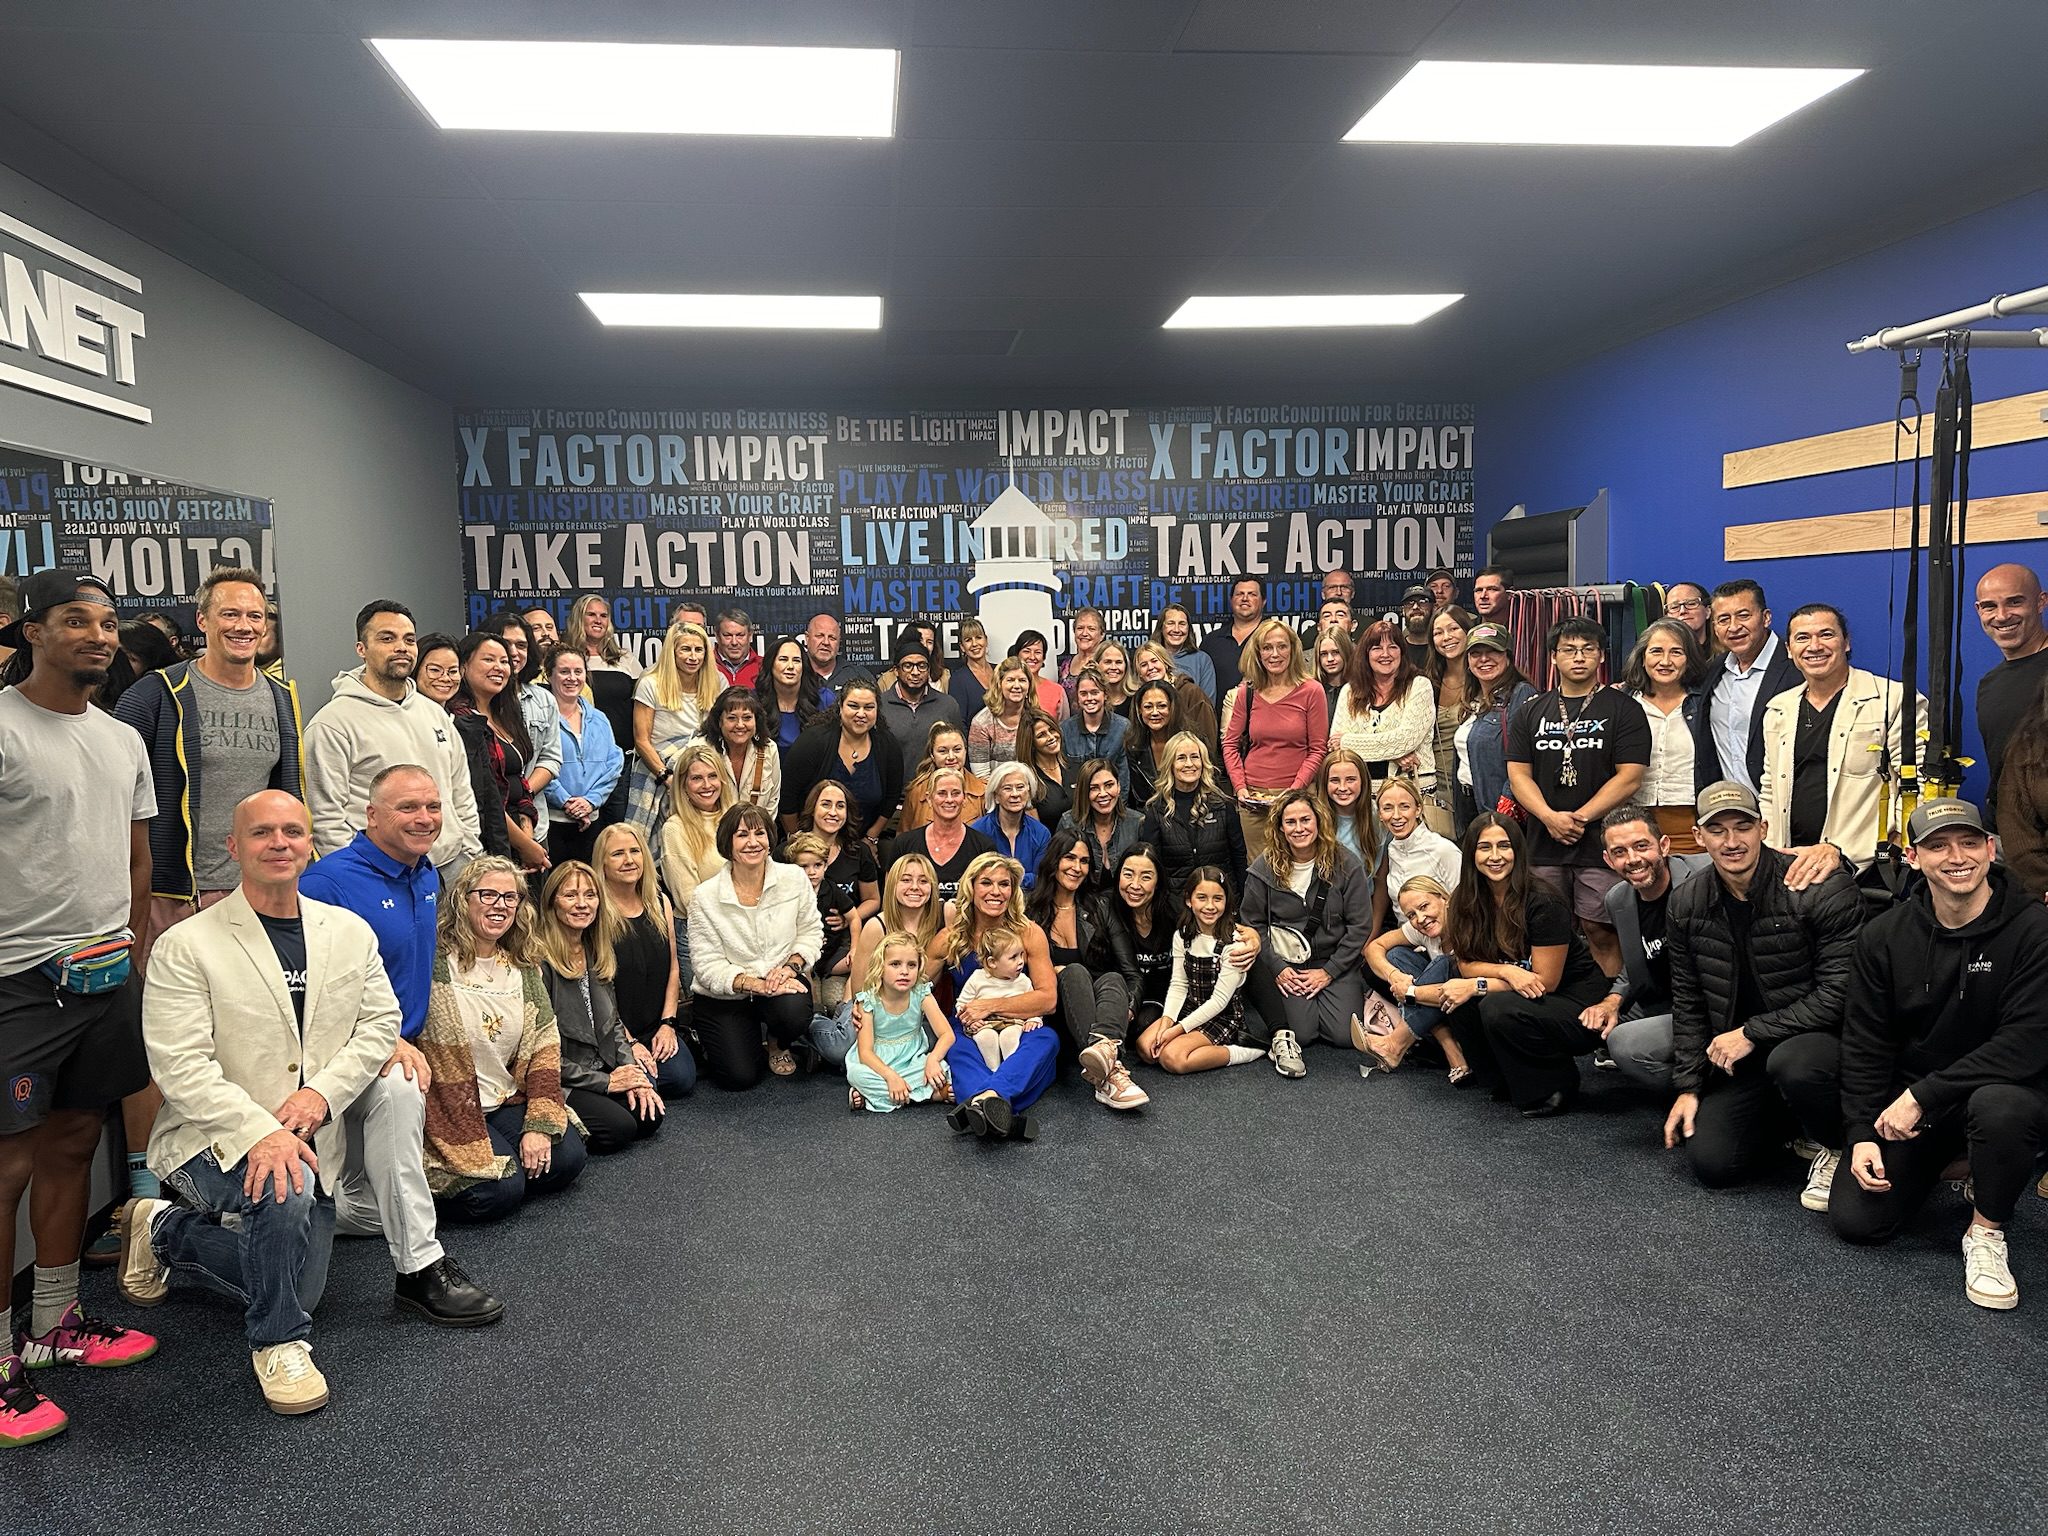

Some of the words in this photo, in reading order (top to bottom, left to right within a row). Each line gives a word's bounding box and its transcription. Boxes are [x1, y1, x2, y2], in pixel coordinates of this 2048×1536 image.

[0, 252, 146, 386] NET
[548, 409, 607, 429] FACTOR
[608, 409, 696, 429] CONDITION
[702, 411, 732, 429] FOR
[737, 409, 828, 430] GREATNESS
[1227, 405, 1278, 424] FACTOR
[1281, 405, 1360, 424] CONDITION
[836, 415, 861, 442] BE
[866, 419, 904, 442] THE
[910, 415, 967, 442] LIGHT
[968, 419, 997, 430] IMPACT
[969, 431, 996, 441] IMPACT
[998, 409, 1129, 456] IMPACT
[1149, 423, 1176, 480] X
[1191, 423, 1351, 479] FACTOR
[1356, 426, 1475, 472] IMPACT
[459, 427, 492, 487] X
[507, 426, 689, 487] FACTOR
[693, 435, 828, 482] IMPACT
[1043, 456, 1057, 467] FOR
[1059, 455, 1101, 467] GREATNESS
[1105, 456, 1112, 469] X
[858, 464, 873, 472] LIVE
[874, 464, 906, 473] INSPIRED
[801, 482, 835, 493] FACTOR
[838, 467, 908, 504] PLAY
[917, 467, 948, 504] AT
[1063, 466, 1147, 502] CLASS
[1150, 483, 1200, 513] LIVE
[1206, 480, 1311, 512] INSPIRED
[1313, 483, 1378, 505] MASTER
[1382, 482, 1425, 503] YOUR
[463, 490, 520, 522] LIVE
[527, 490, 648, 521] INSPIRED
[650, 493, 722, 515] MASTER
[726, 492, 774, 515] YOUR
[778, 492, 833, 515] CRAFT
[939, 504, 963, 513] IMPACT
[1376, 504, 1399, 515] PLAY
[1400, 504, 1412, 514] AT
[1413, 503, 1445, 514] WORLD
[1446, 501, 1474, 513] CLASS
[870, 505, 897, 520] TAKE
[899, 505, 938, 520] ACTION
[1189, 512, 1224, 521] CONDITION
[1224, 512, 1237, 520] FOR
[1238, 511, 1275, 520] GREATNESS
[509, 521, 549, 531] CONDITION
[550, 522, 565, 531] FOR
[566, 521, 608, 531] GREATNESS
[721, 516, 746, 529] PLAY
[748, 516, 761, 528] AT
[762, 516, 797, 528] WORLD
[799, 515, 830, 528] CLASS
[841, 514, 930, 566] LIVE
[1150, 515, 1269, 577] TAKE
[1285, 512, 1456, 573] ACTION
[465, 525, 605, 590] TAKE
[622, 523, 812, 588] ACTION
[813, 569, 837, 578] IMPACT
[866, 566, 906, 579] MASTER
[909, 566, 935, 578] YOUR
[937, 565, 967, 578] CRAFT
[1213, 575, 1230, 583] CLASS
[1384, 571, 1411, 581] MASTER
[493, 590, 509, 599] PLAY
[518, 589, 541, 598] WORLD
[541, 589, 561, 598] CLASS
[735, 587, 764, 597] MASTER
[766, 587, 785, 597] YOUR
[786, 586, 811, 597] CRAFT
[810, 585, 839, 596] IMPACT
[843, 576, 962, 614] MASTER
[1054, 570, 1143, 609] CRAFT
[919, 612, 927, 621] BE
[930, 612, 942, 621] THE
[943, 611, 964, 621] LIGHT
[845, 623, 873, 634] IMPACT
[852, 653, 874, 662] FACTOR
[218, 729, 279, 752] MARY
[1535, 737, 1603, 750] COACH
